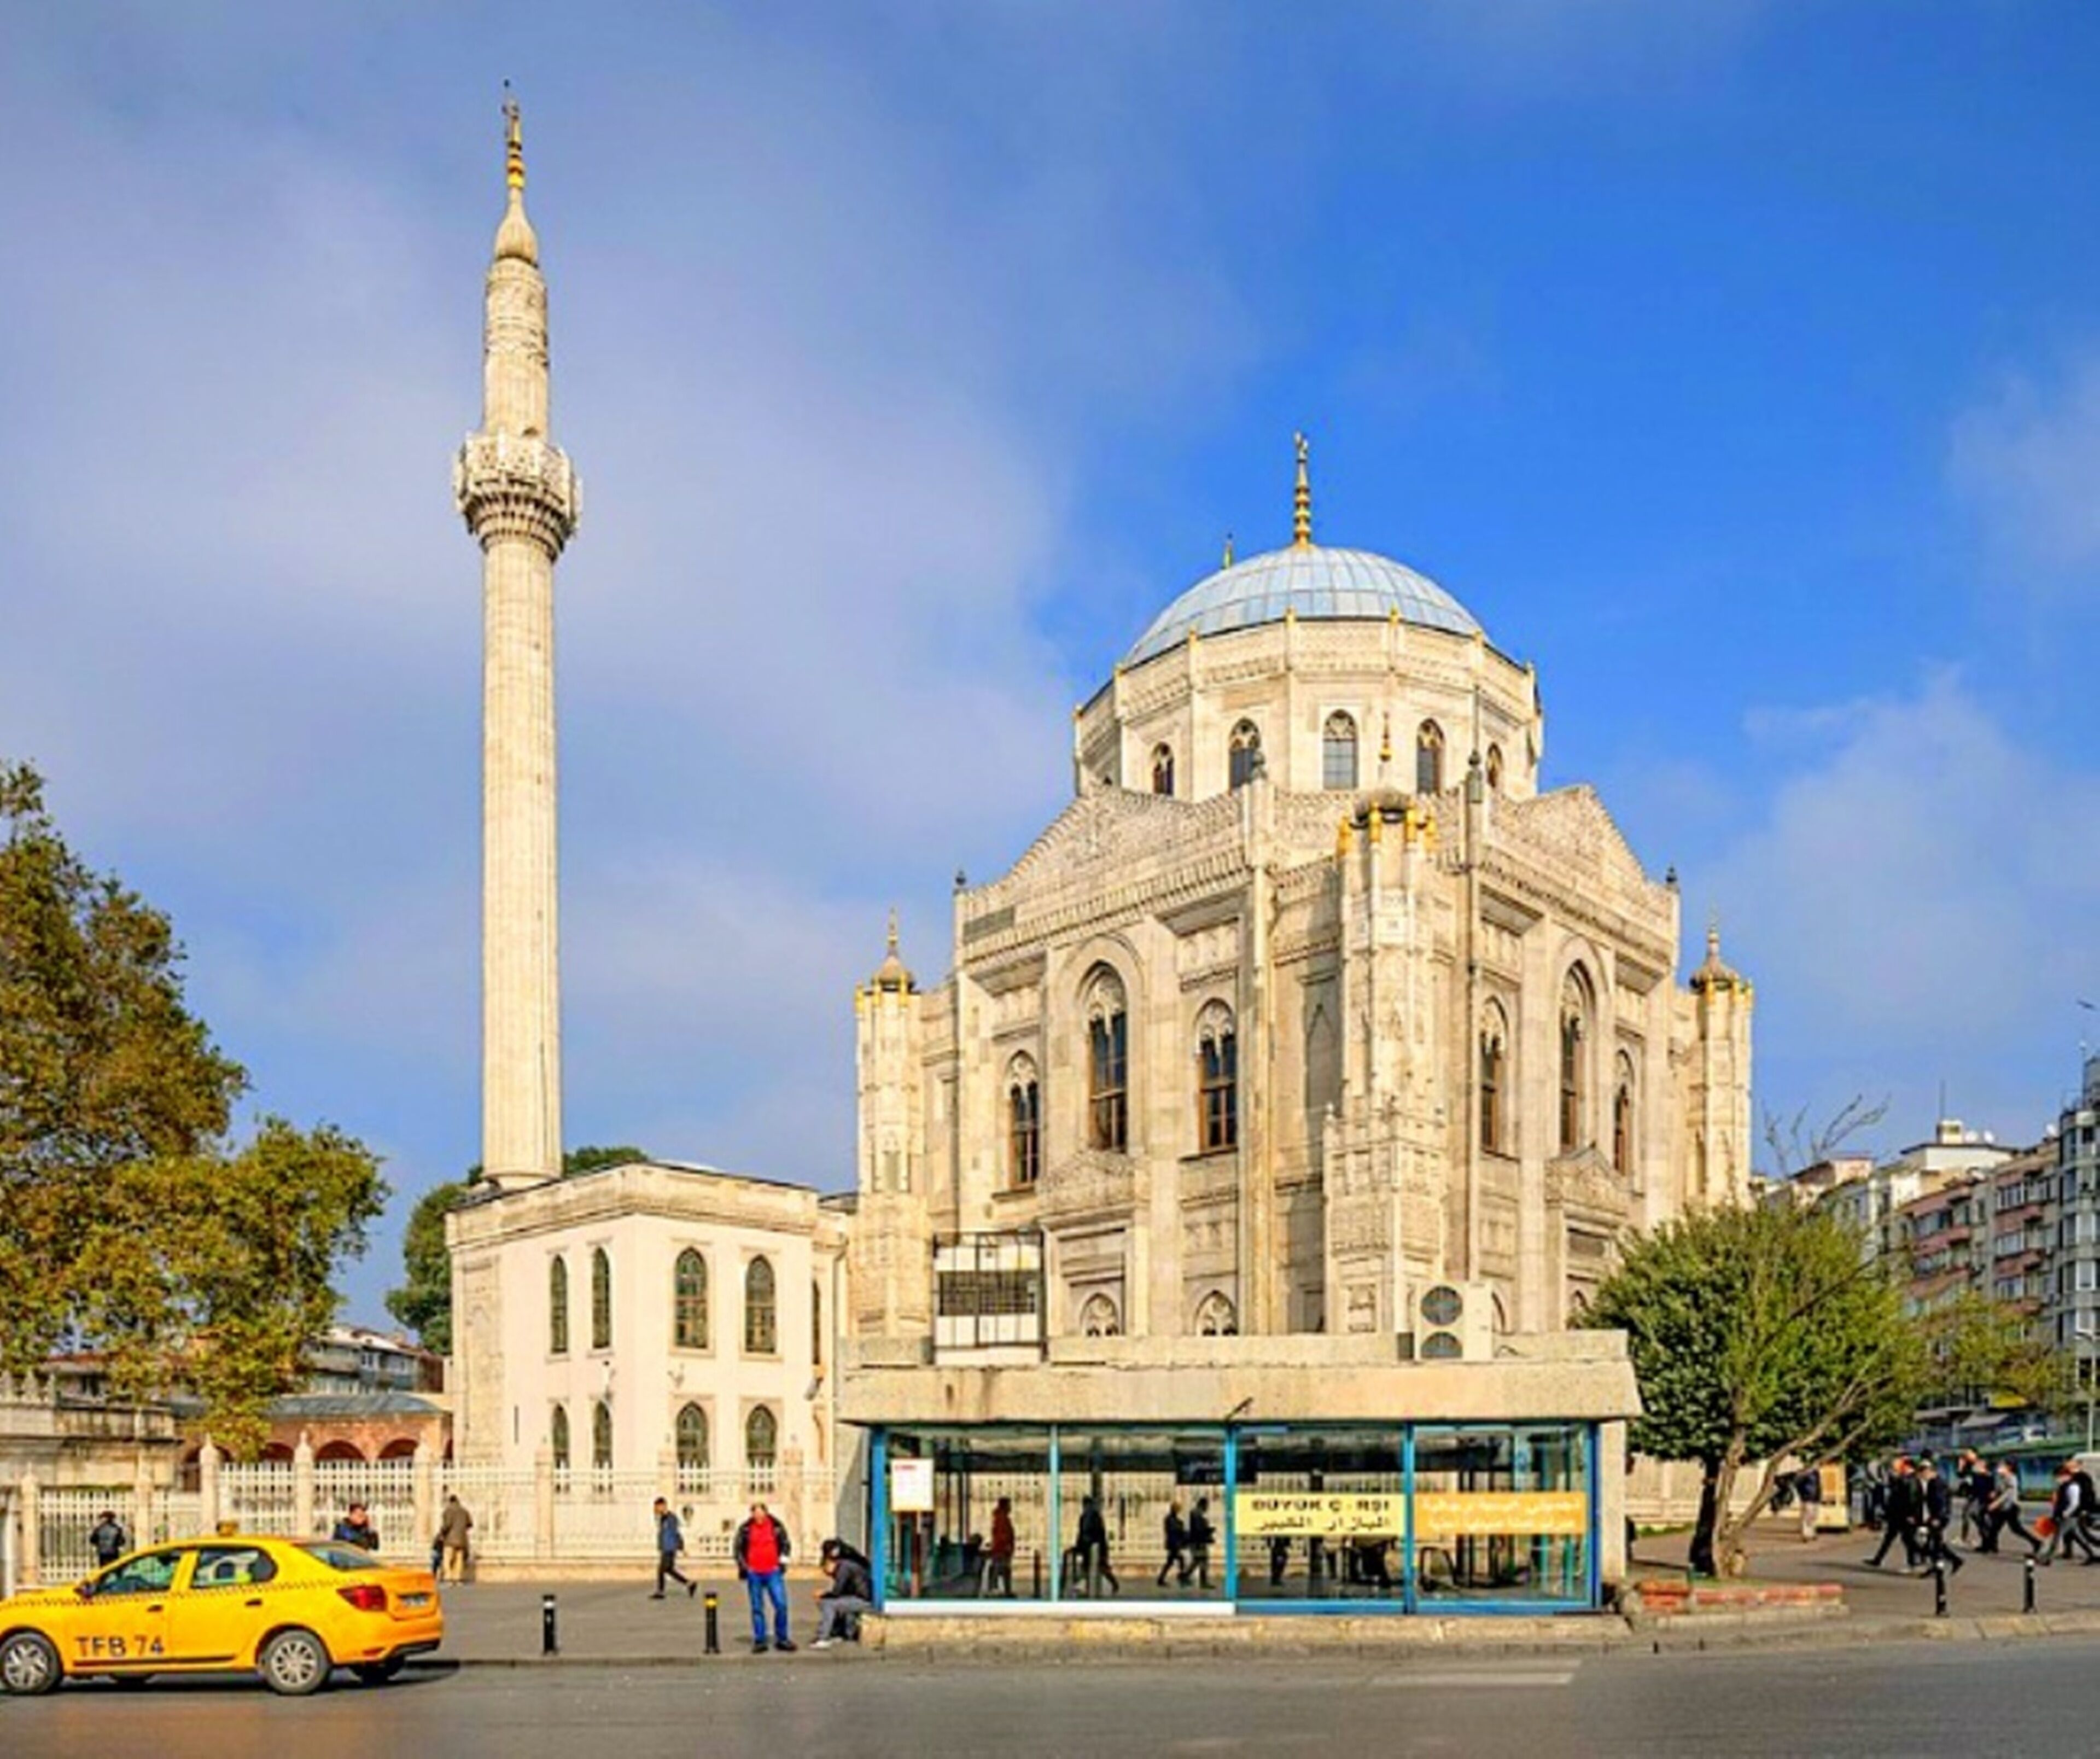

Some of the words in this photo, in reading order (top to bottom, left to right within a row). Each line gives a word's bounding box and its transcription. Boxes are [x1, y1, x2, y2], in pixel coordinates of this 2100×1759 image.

[1328, 1499, 1389, 1513] ÇRŞI
[74, 1635, 127, 1657] TFB
[134, 1634, 165, 1656] 74
